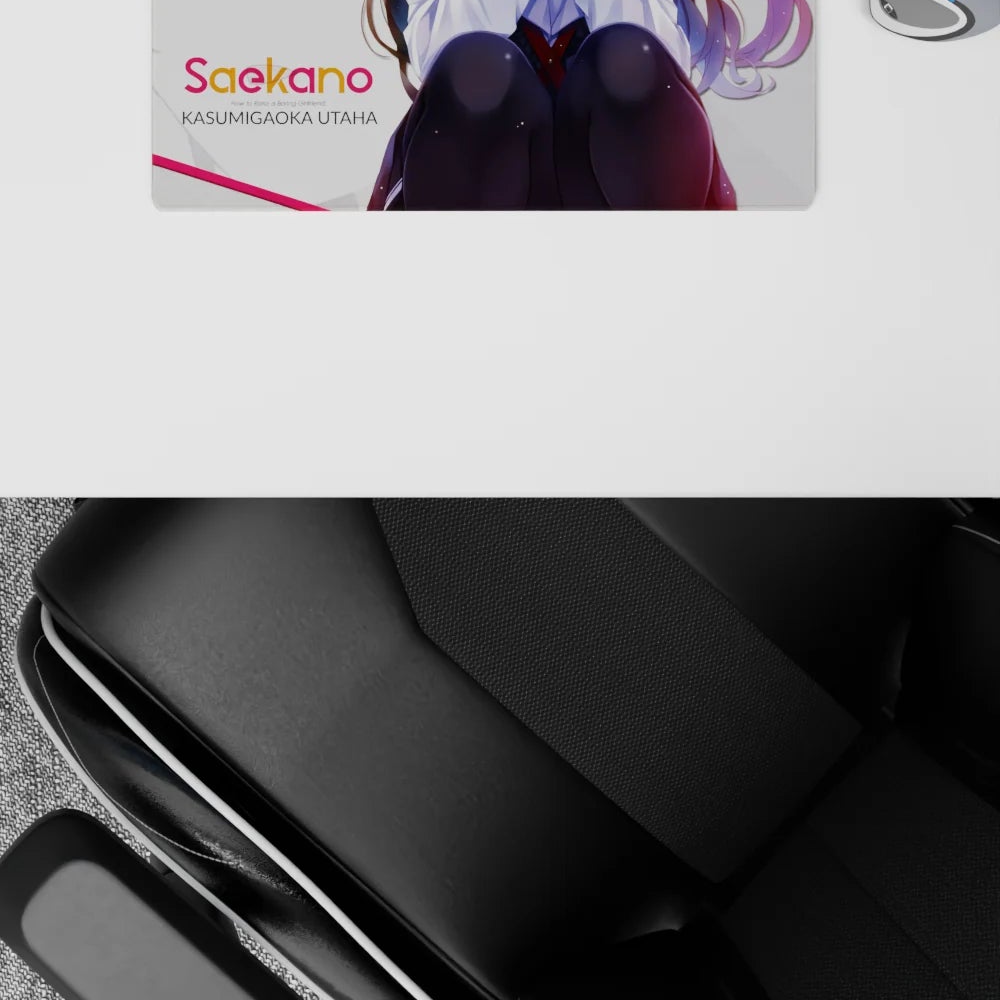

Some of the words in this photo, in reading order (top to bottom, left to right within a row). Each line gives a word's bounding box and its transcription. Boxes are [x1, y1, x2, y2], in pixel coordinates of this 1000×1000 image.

[184, 56, 373, 94] Saekano
[182, 111, 313, 125] KASUMIGAOKA
[318, 111, 378, 125] UTAHA
